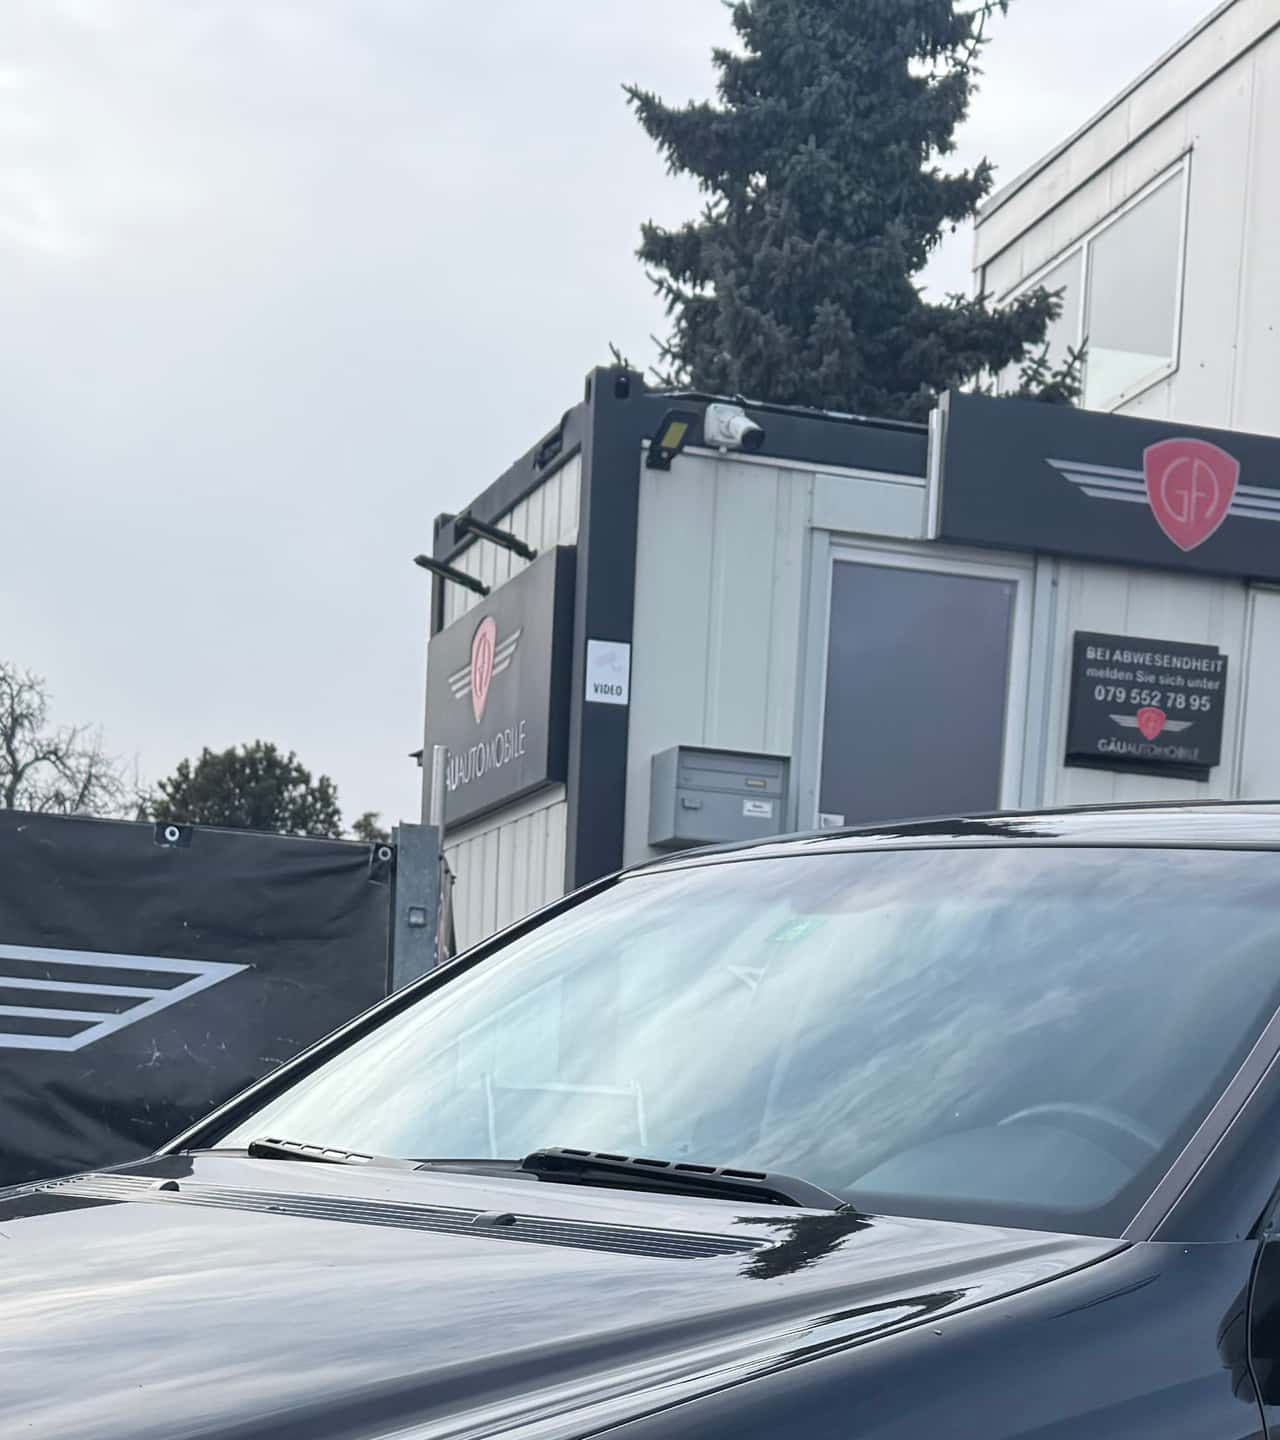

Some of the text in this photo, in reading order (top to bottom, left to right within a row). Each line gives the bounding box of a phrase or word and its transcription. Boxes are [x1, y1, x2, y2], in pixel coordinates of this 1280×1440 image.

[1086, 646, 1223, 672] BEI ABWESENDHEIT
[593, 682, 623, 696] VIDEO
[1085, 666, 1220, 690] melden Sie sich unter
[1094, 685, 1211, 711] 079 552 78 95
